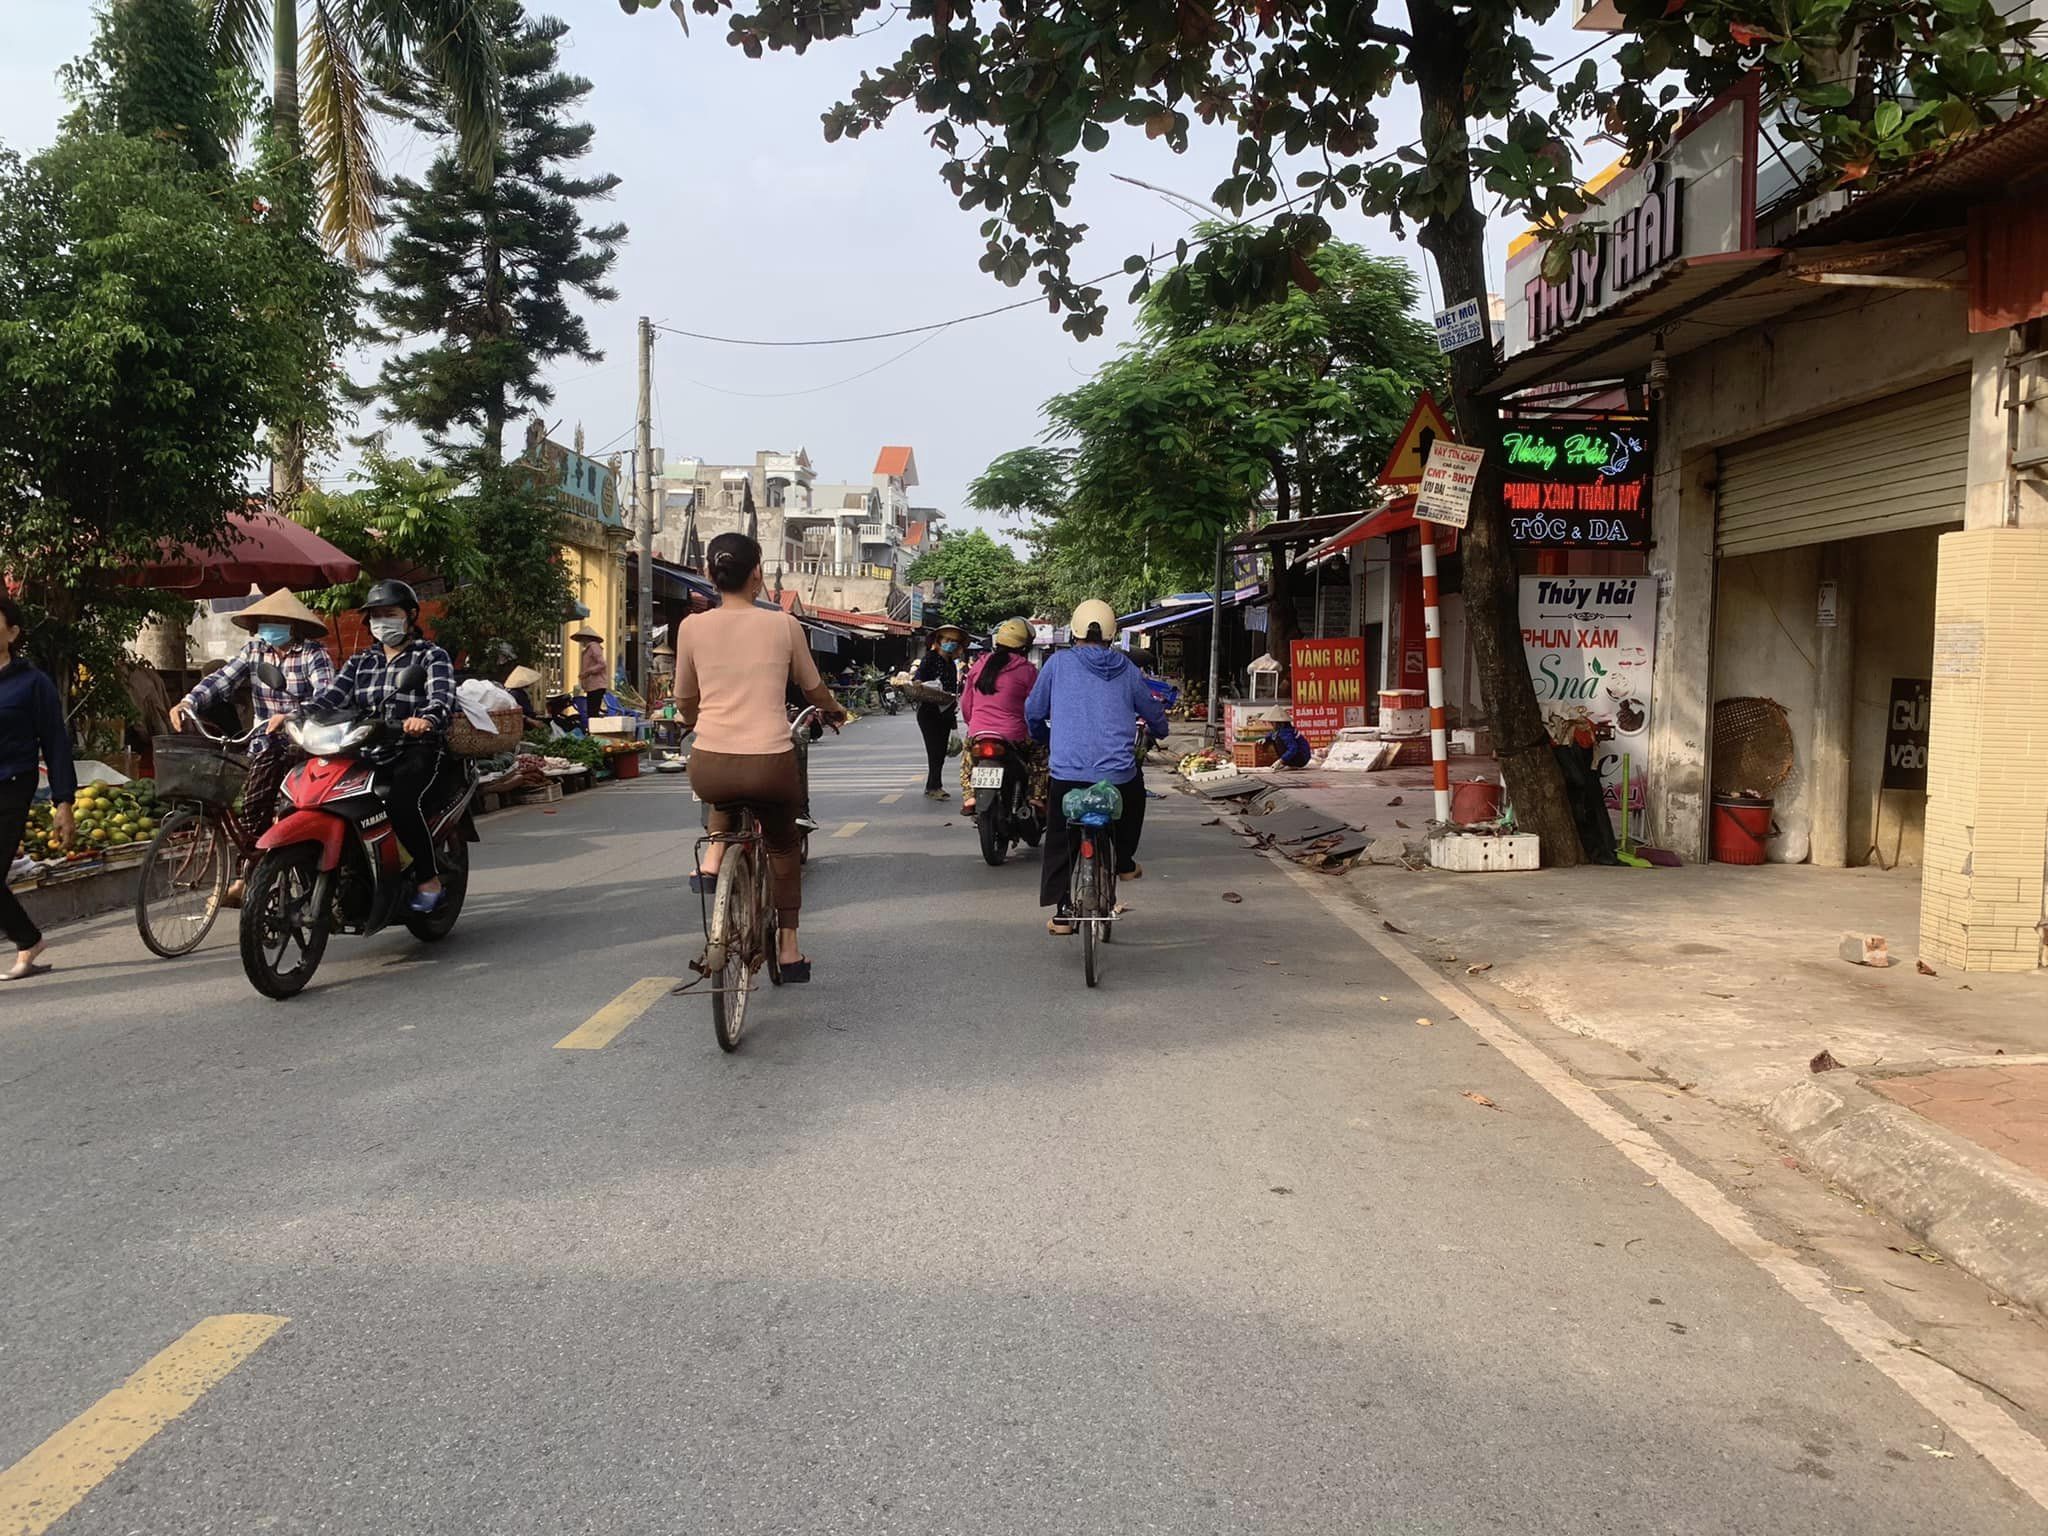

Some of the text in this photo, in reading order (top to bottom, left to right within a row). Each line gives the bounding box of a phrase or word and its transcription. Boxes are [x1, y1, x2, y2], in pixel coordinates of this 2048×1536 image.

[1613, 163, 1684, 291] HẢI
[1503, 433, 1609, 470] Thủy Hải
[1427, 467, 1475, 486] CMT BHYT
[1504, 482, 1540, 509] PHUN
[1618, 480, 1642, 511] MỸ
[1511, 512, 1629, 541] TÓC & DA
[1538, 579, 1592, 609] Thủy
[1596, 580, 1637, 605] Hải
[1520, 626, 1618, 648] PHUN XĂM
[1296, 644, 1360, 672] VÀNG BẠC
[1296, 672, 1360, 705] HẢI ANH
[360, 811, 388, 829] YAMAHA
